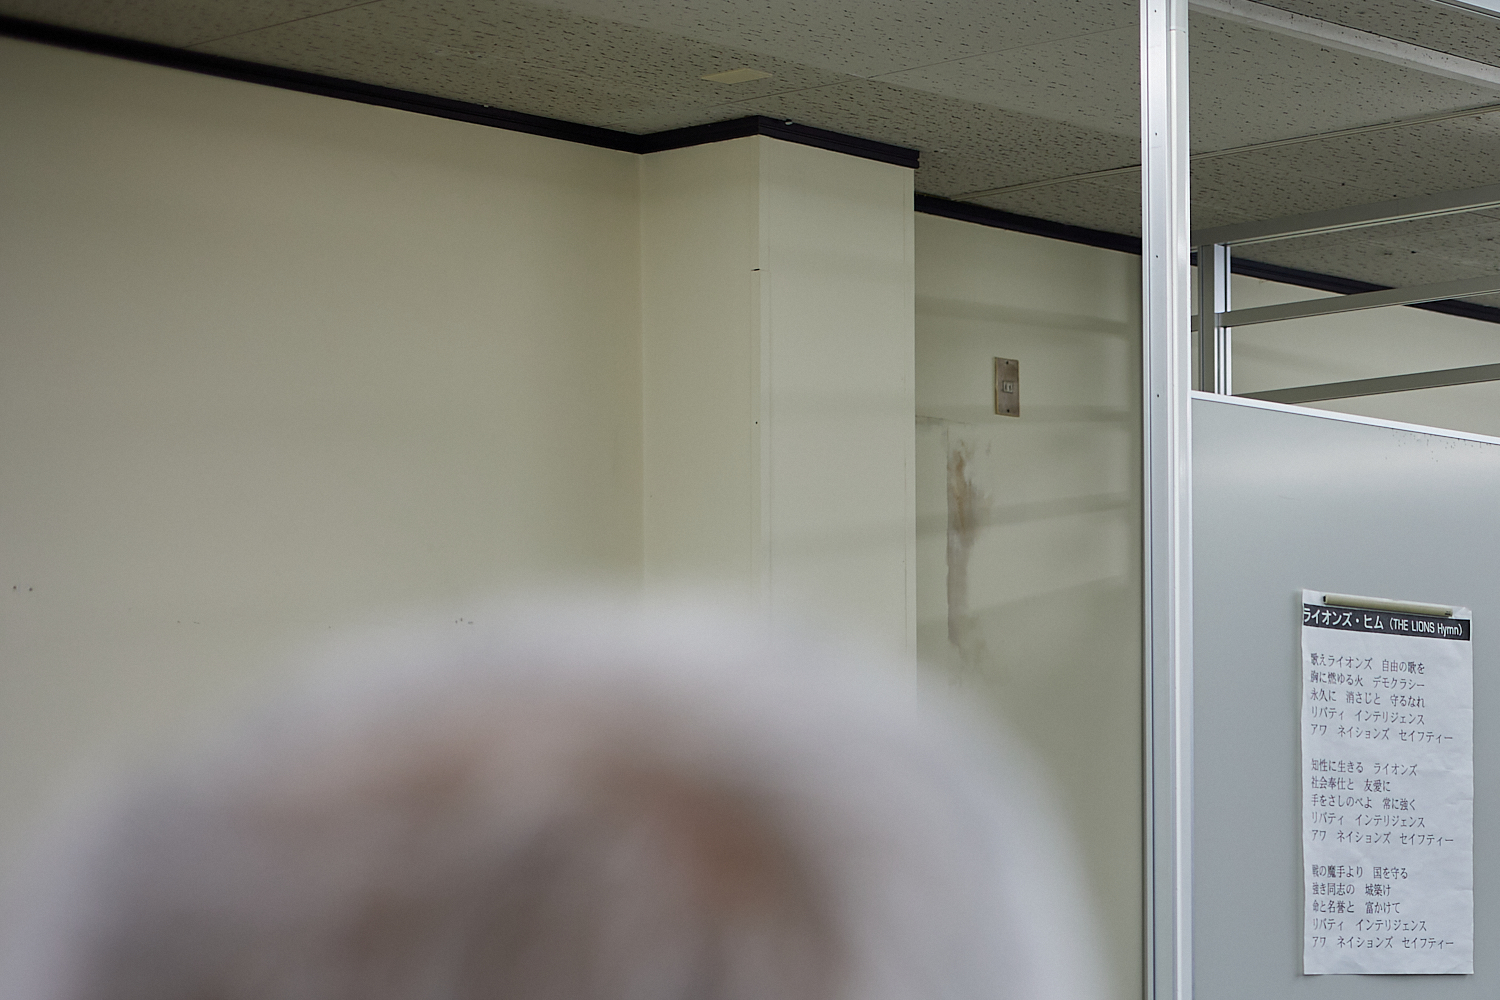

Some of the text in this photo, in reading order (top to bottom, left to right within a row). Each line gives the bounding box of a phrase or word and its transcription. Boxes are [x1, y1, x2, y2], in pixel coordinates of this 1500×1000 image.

[1303, 608, 1384, 630] ライオンズ・ヒム
[1411, 620, 1435, 633] LIONS
[1310, 652, 1425, 675] 歌えライオンズ 自由の歌を
[1310, 670, 1425, 690] 胸に燃ゆる火 デモクラシー
[1310, 688, 1425, 708] 永久に 消さじと 守るなれ
[1354, 709, 1425, 725] インテリジェンス
[1310, 723, 1453, 744] アワ ネイションズ セイフティー
[1311, 758, 1418, 776] 知性に生きる ライオンズ
[1311, 775, 1391, 793] 社会奉仕と 友愛に
[1311, 793, 1416, 811] 手をさしのべよ 常に強く
[1355, 814, 1426, 828] インテリジェンス
[1311, 829, 1454, 847] アワ ネイションズ セイフティー
[1372, 866, 1408, 880] 国を守る
[1312, 882, 1392, 897] 強き同志の 城築け
[1365, 901, 1401, 915] 富かけて
[1355, 918, 1427, 932] インテリジェンス
[1312, 935, 1454, 950] アワ ネイションズ セイフティー
